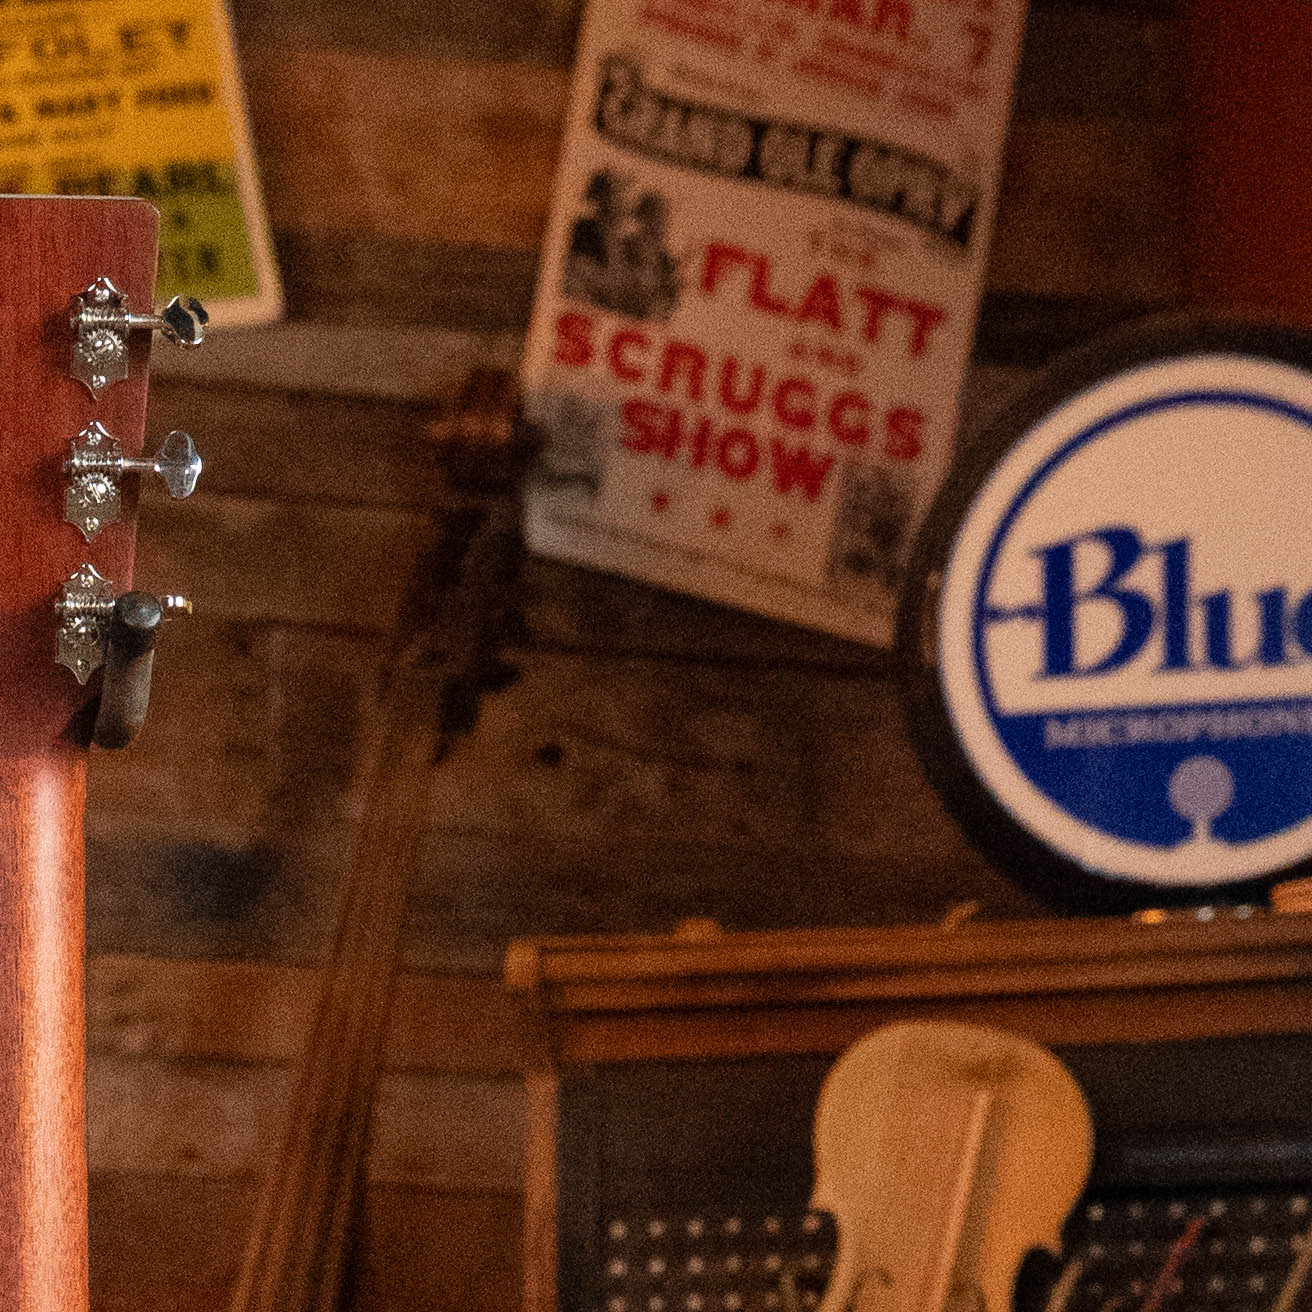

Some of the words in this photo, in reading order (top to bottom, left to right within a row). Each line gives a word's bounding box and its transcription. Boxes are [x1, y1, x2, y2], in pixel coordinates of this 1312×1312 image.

[701, 240, 947, 360] FLATT
[552, 309, 925, 462] SCRUGGS
[620, 397, 837, 503] SHOW
